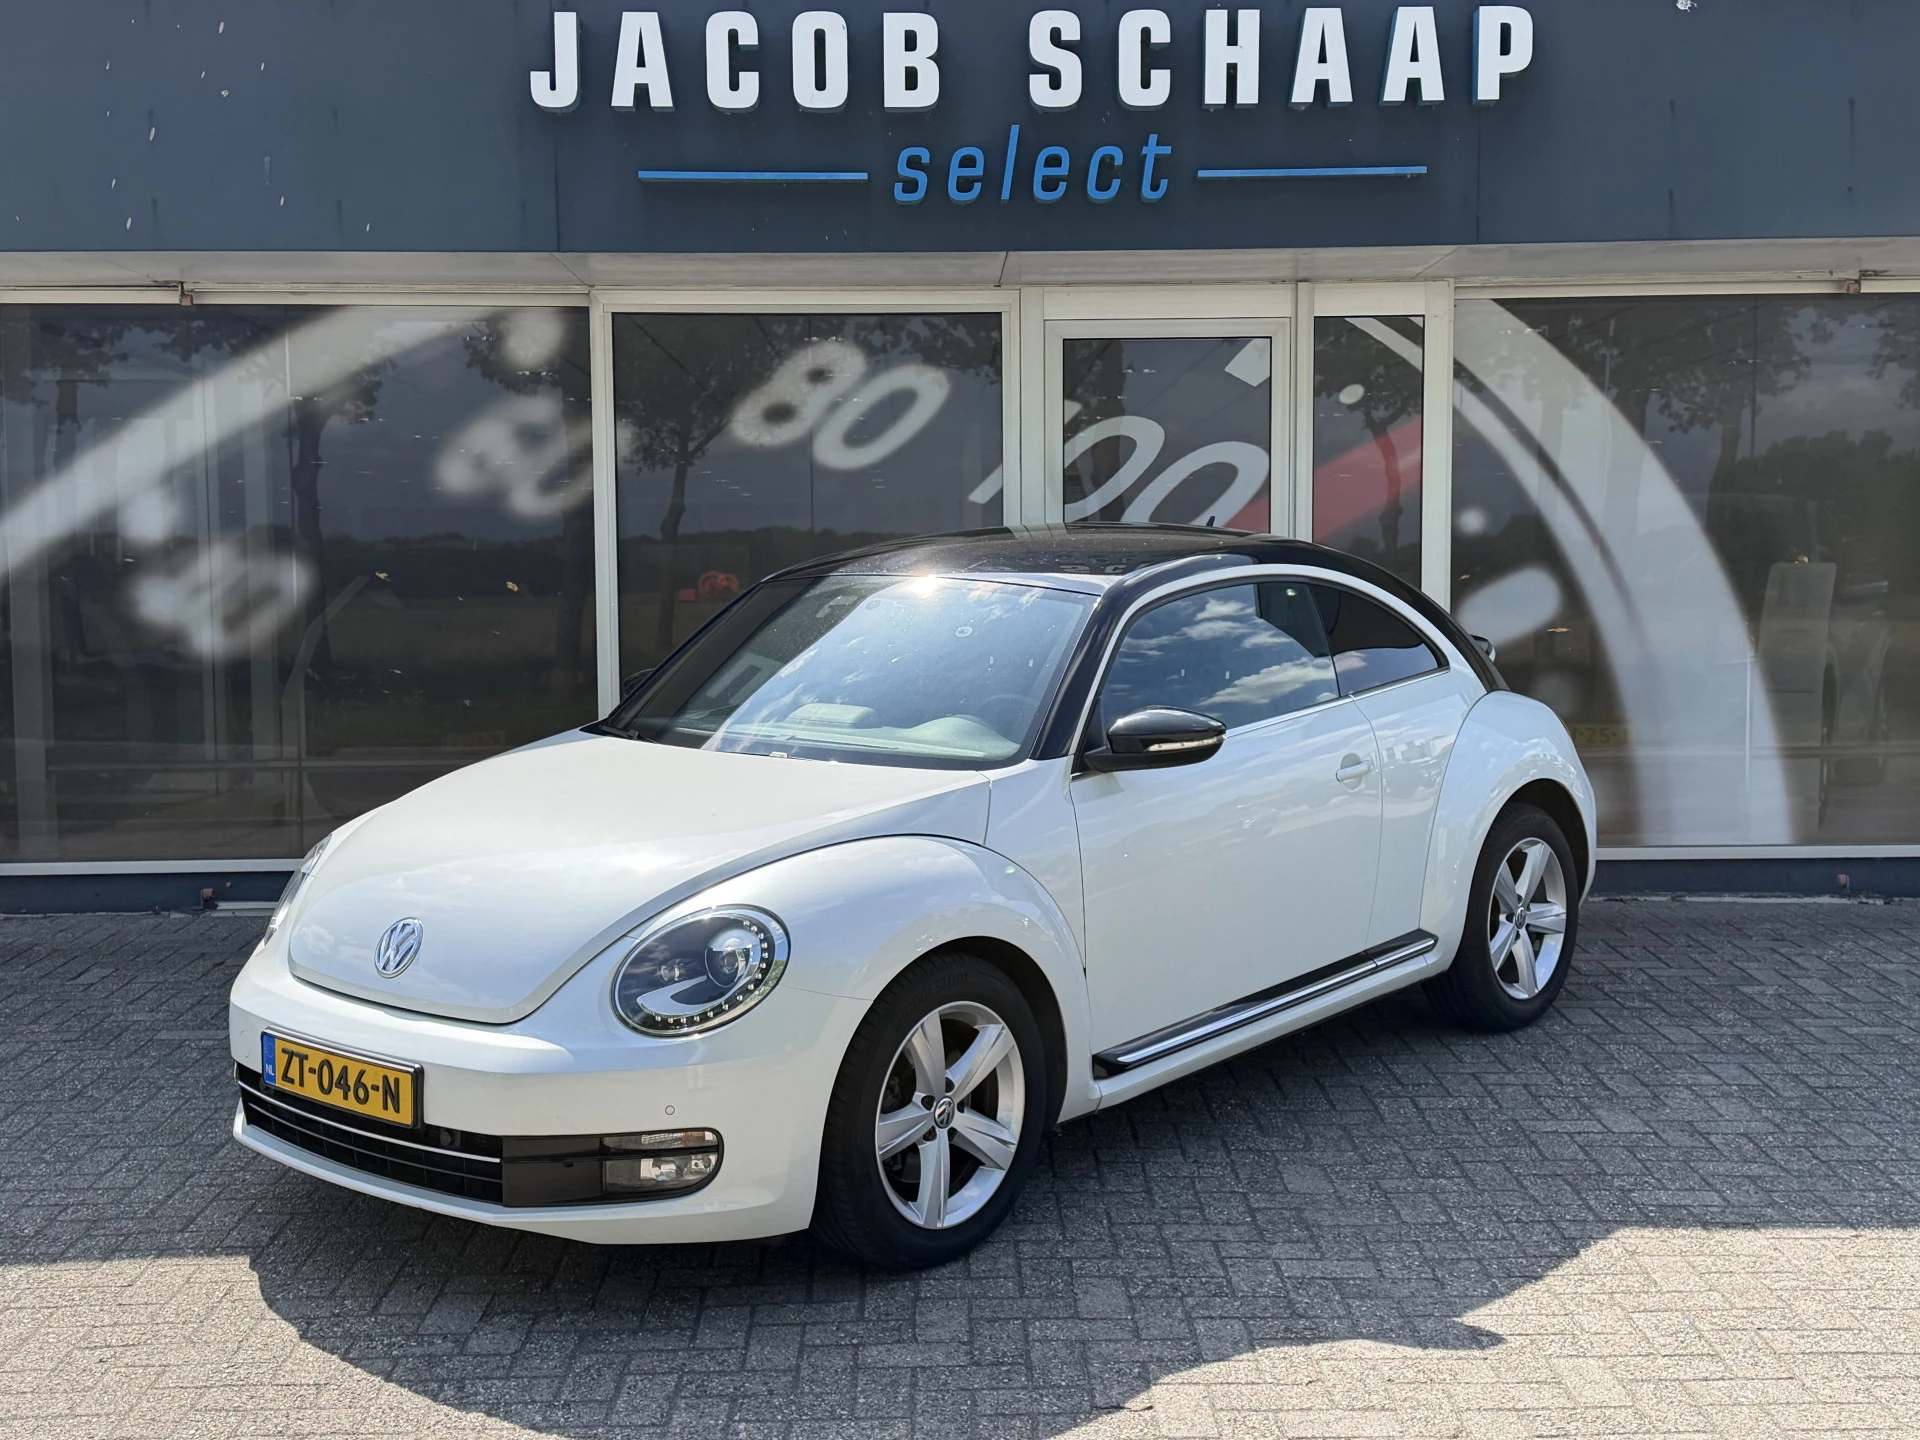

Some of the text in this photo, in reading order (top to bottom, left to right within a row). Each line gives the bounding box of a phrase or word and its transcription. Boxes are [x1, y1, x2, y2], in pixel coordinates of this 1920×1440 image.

[529, 6, 1534, 109] JACOB SCHAAP
[893, 124, 1172, 203] select
[730, 341, 950, 470] 80
[265, 1047, 401, 1115] NL ZT-046-N
